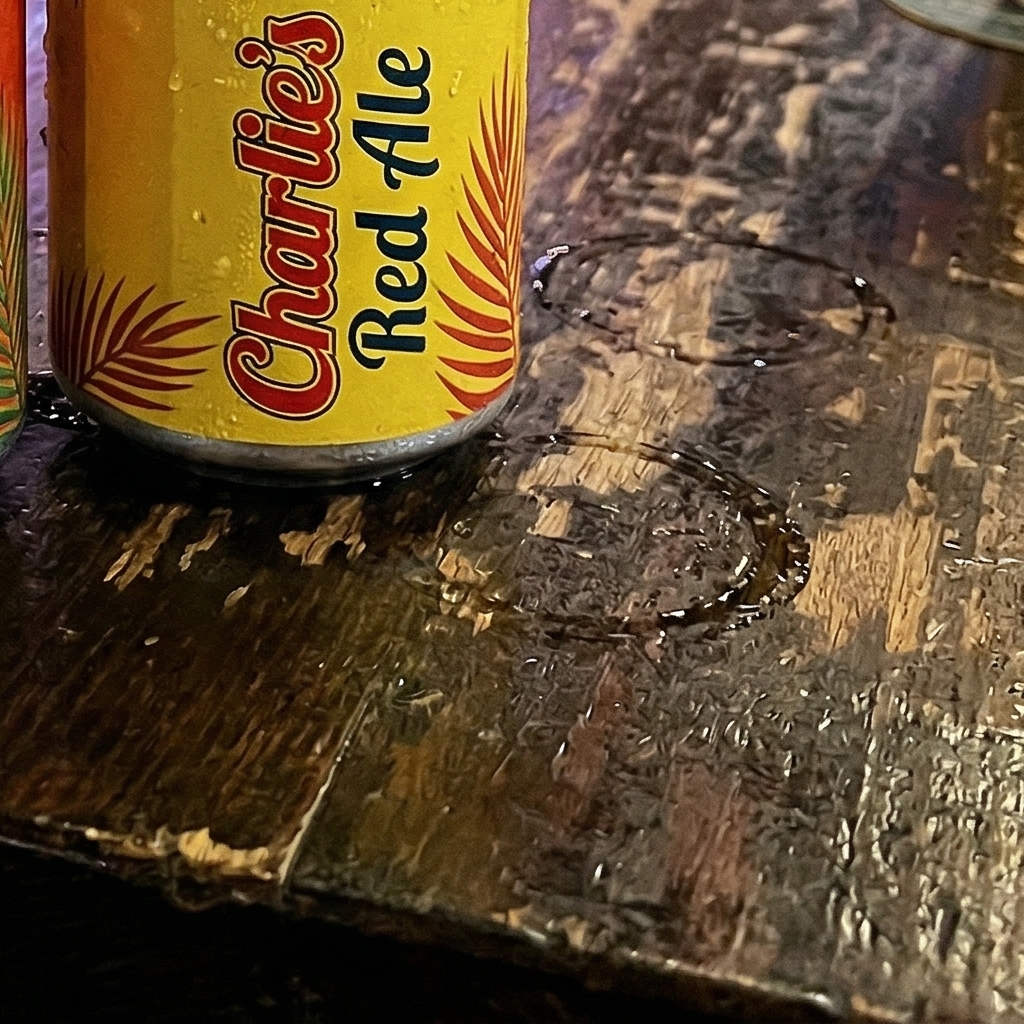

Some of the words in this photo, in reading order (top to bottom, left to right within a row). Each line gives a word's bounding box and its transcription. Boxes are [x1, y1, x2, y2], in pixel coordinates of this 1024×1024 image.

[352, 45, 440, 191] Ale
[224, 11, 343, 421] Charlie's
[348, 206, 428, 370] Red
